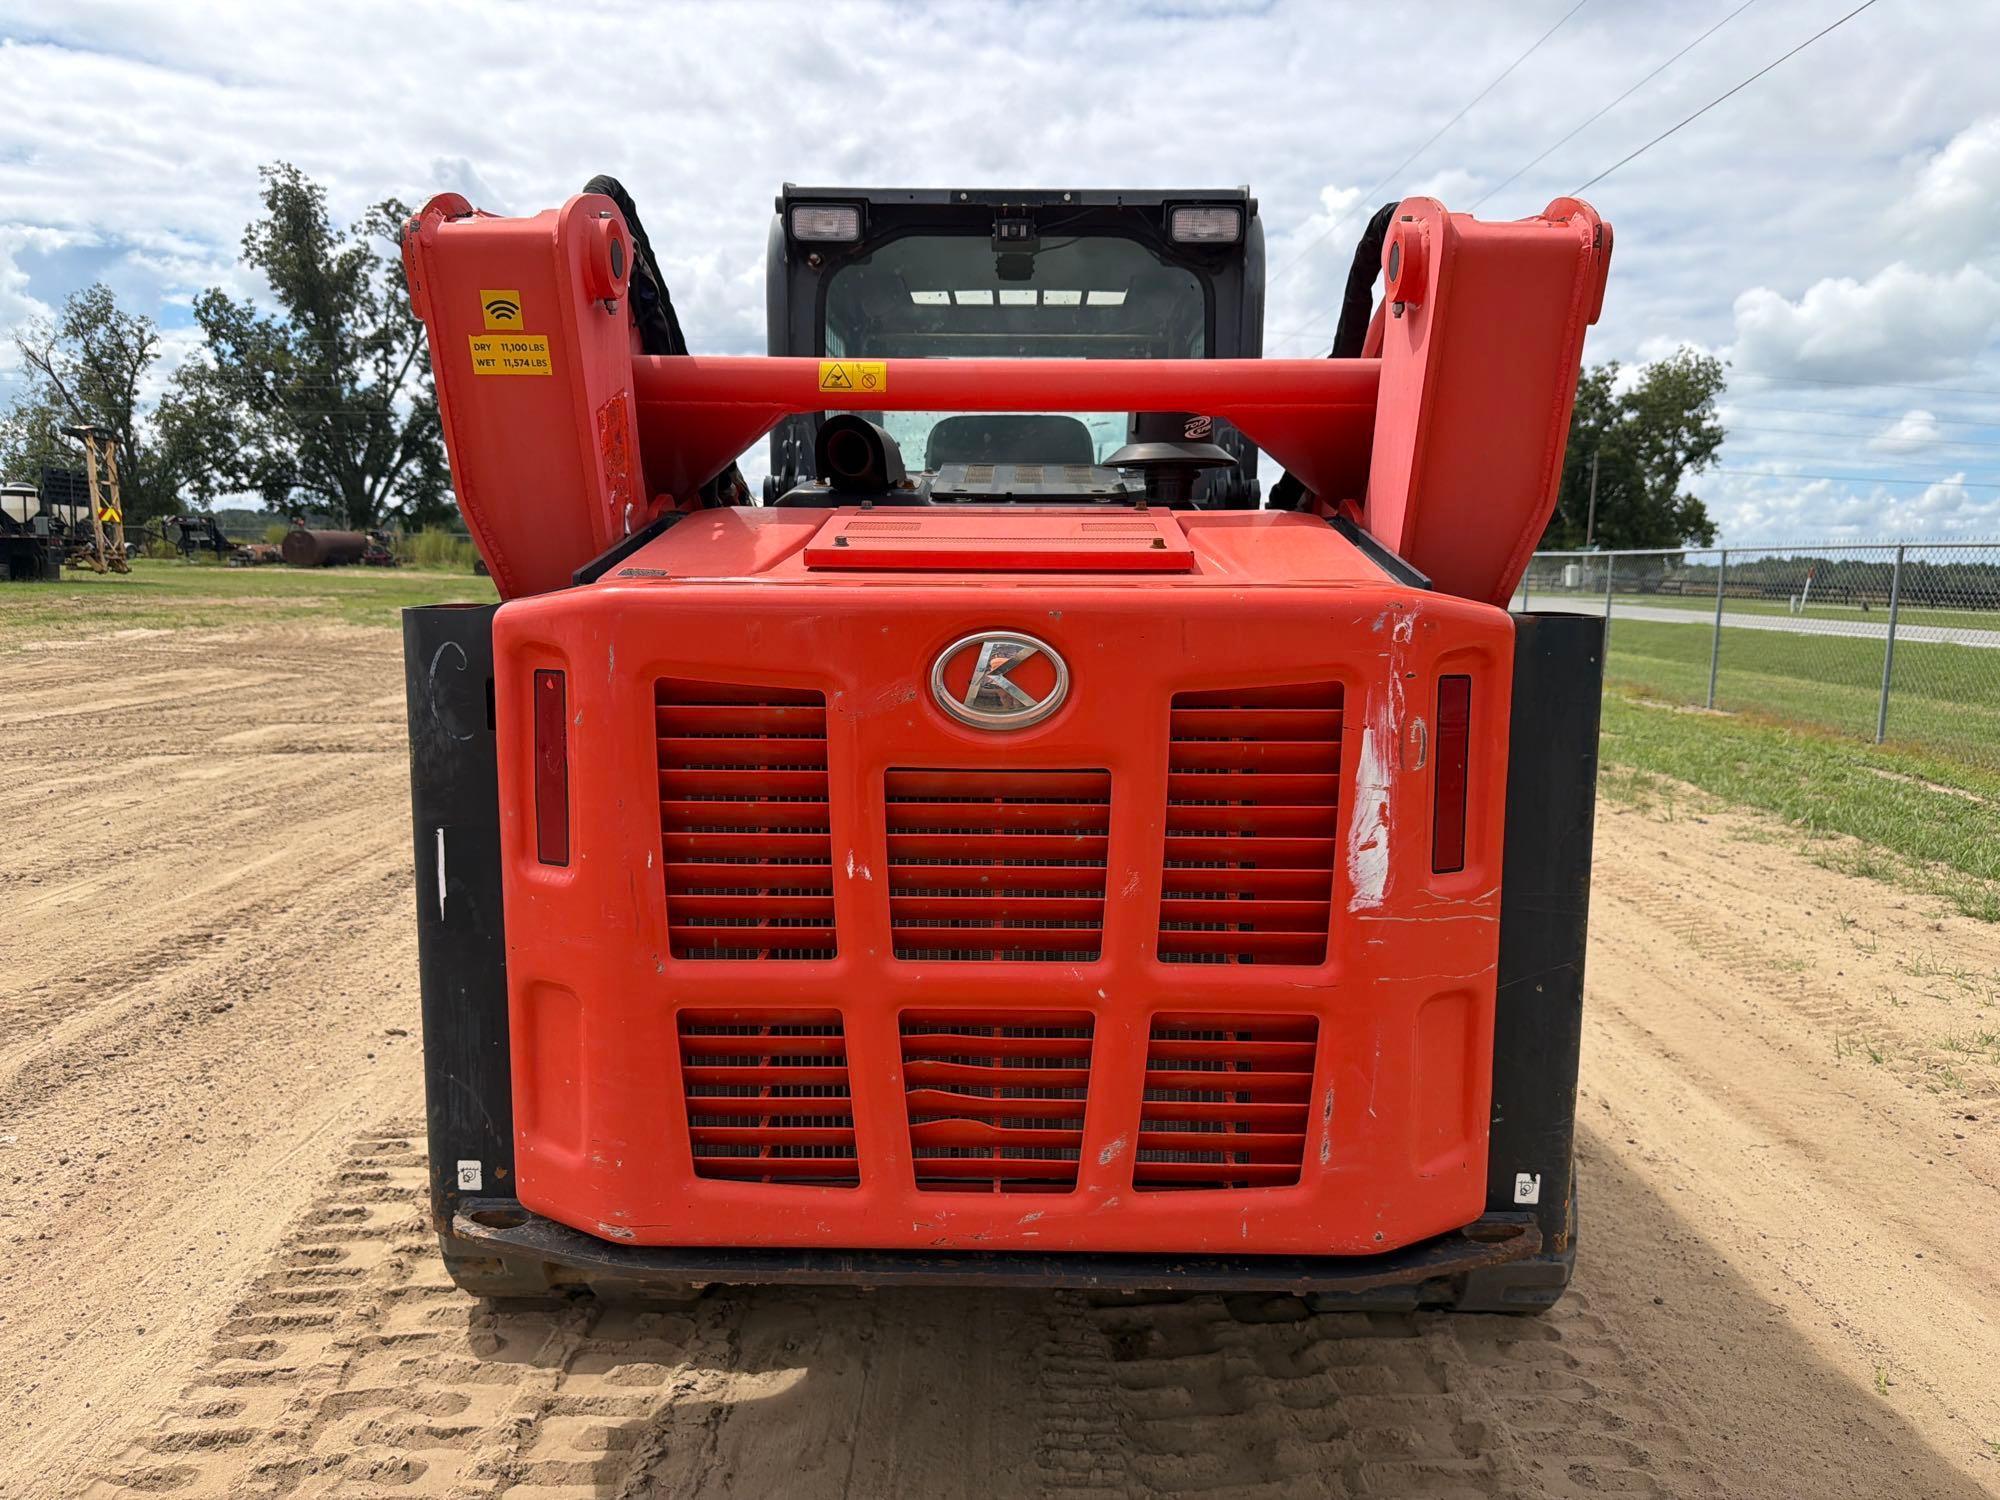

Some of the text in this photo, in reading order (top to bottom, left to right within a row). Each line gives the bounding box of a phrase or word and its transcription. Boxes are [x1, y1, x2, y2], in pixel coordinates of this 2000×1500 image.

[474, 343, 545, 353] DRY 11,100 LBS
[477, 359, 548, 369] WET 11,574 LBS
